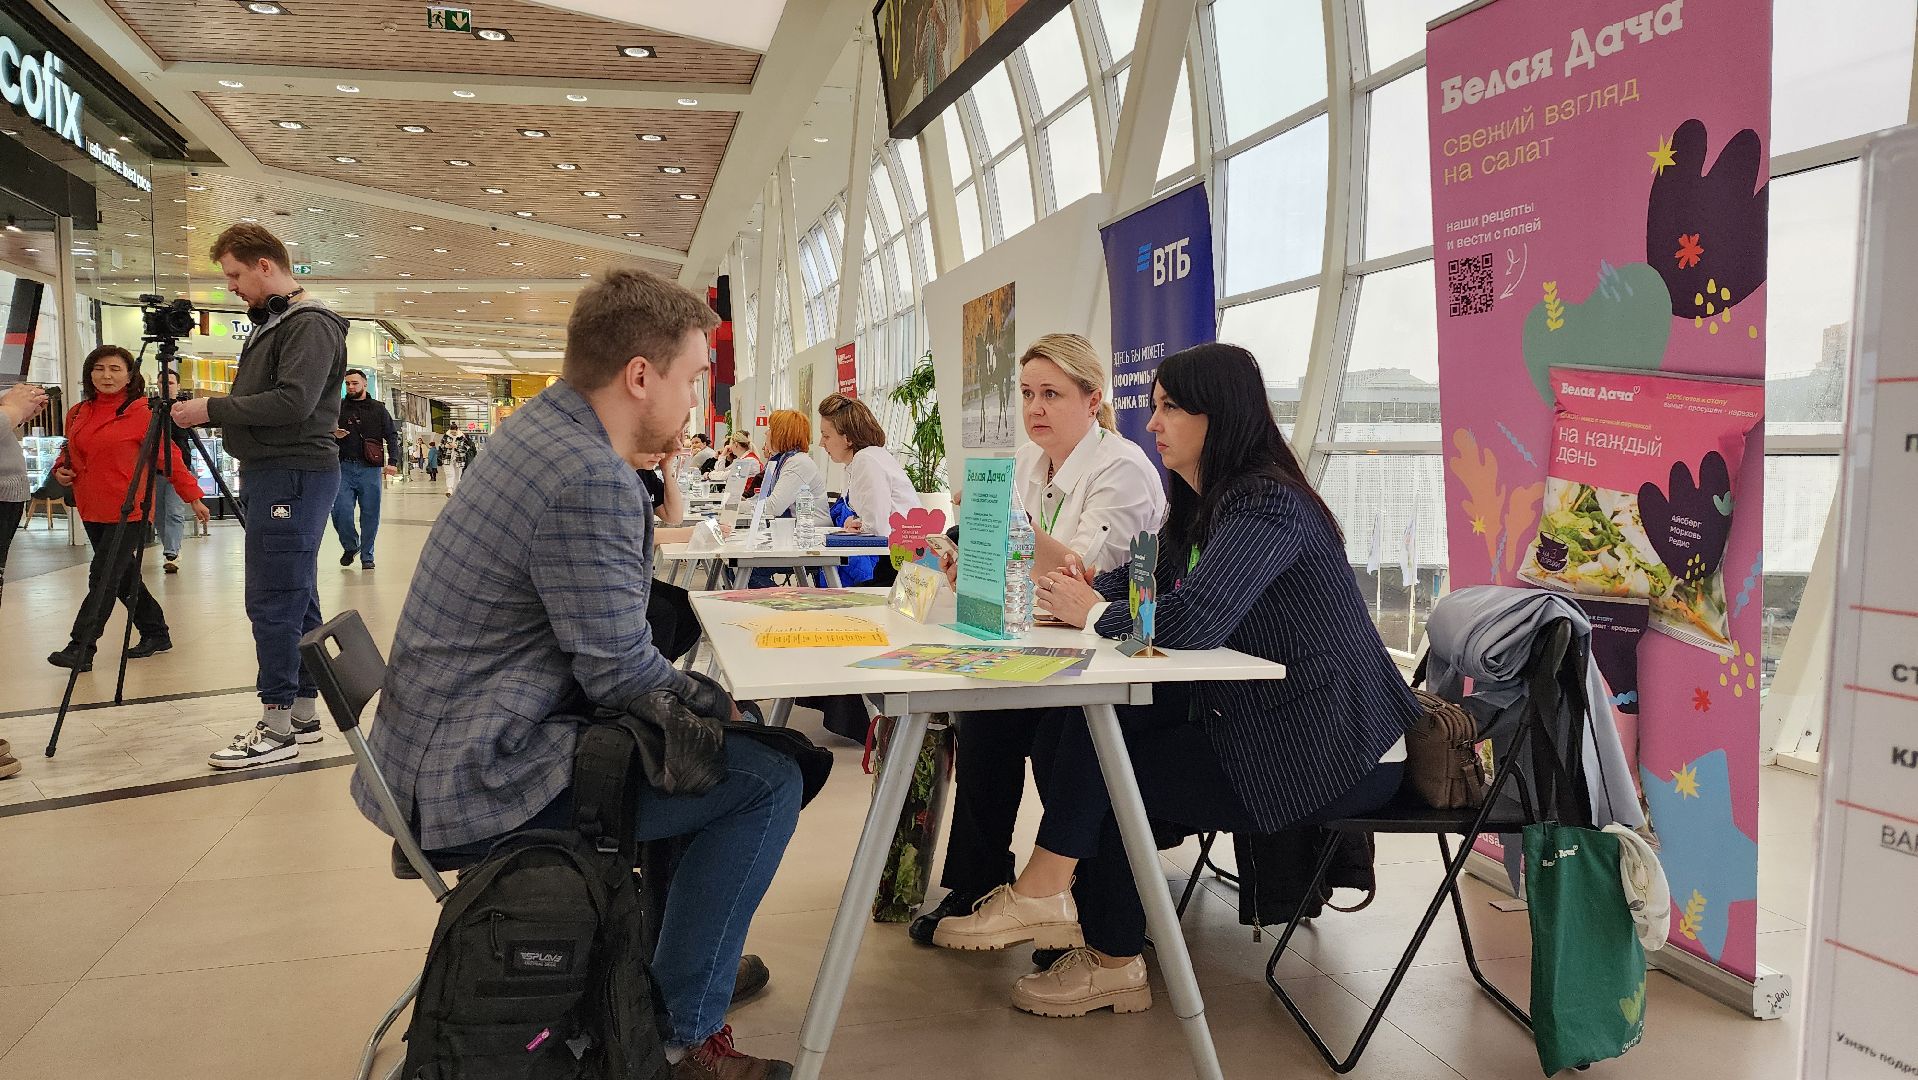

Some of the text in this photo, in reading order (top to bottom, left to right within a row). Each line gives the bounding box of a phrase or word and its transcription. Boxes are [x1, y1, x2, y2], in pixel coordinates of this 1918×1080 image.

[1441, 0, 1684, 114] Белая Дача
[0, 36, 86, 149] cofix
[1443, 78, 1640, 157] свежий взгляд
[1443, 137, 1554, 186] на салат
[1446, 202, 1535, 232] наши рецепты
[1447, 217, 1542, 251] и вести с полей
[1153, 237, 1191, 287] ВТБ
[1561, 383, 1634, 402] Белая Дача
[1556, 446, 1598, 467] день
[1559, 426, 1663, 458] на каждый
[1670, 526, 1702, 540] Морковь
[1672, 515, 1703, 529] Айсберг
[1669, 537, 1690, 549] Редис
